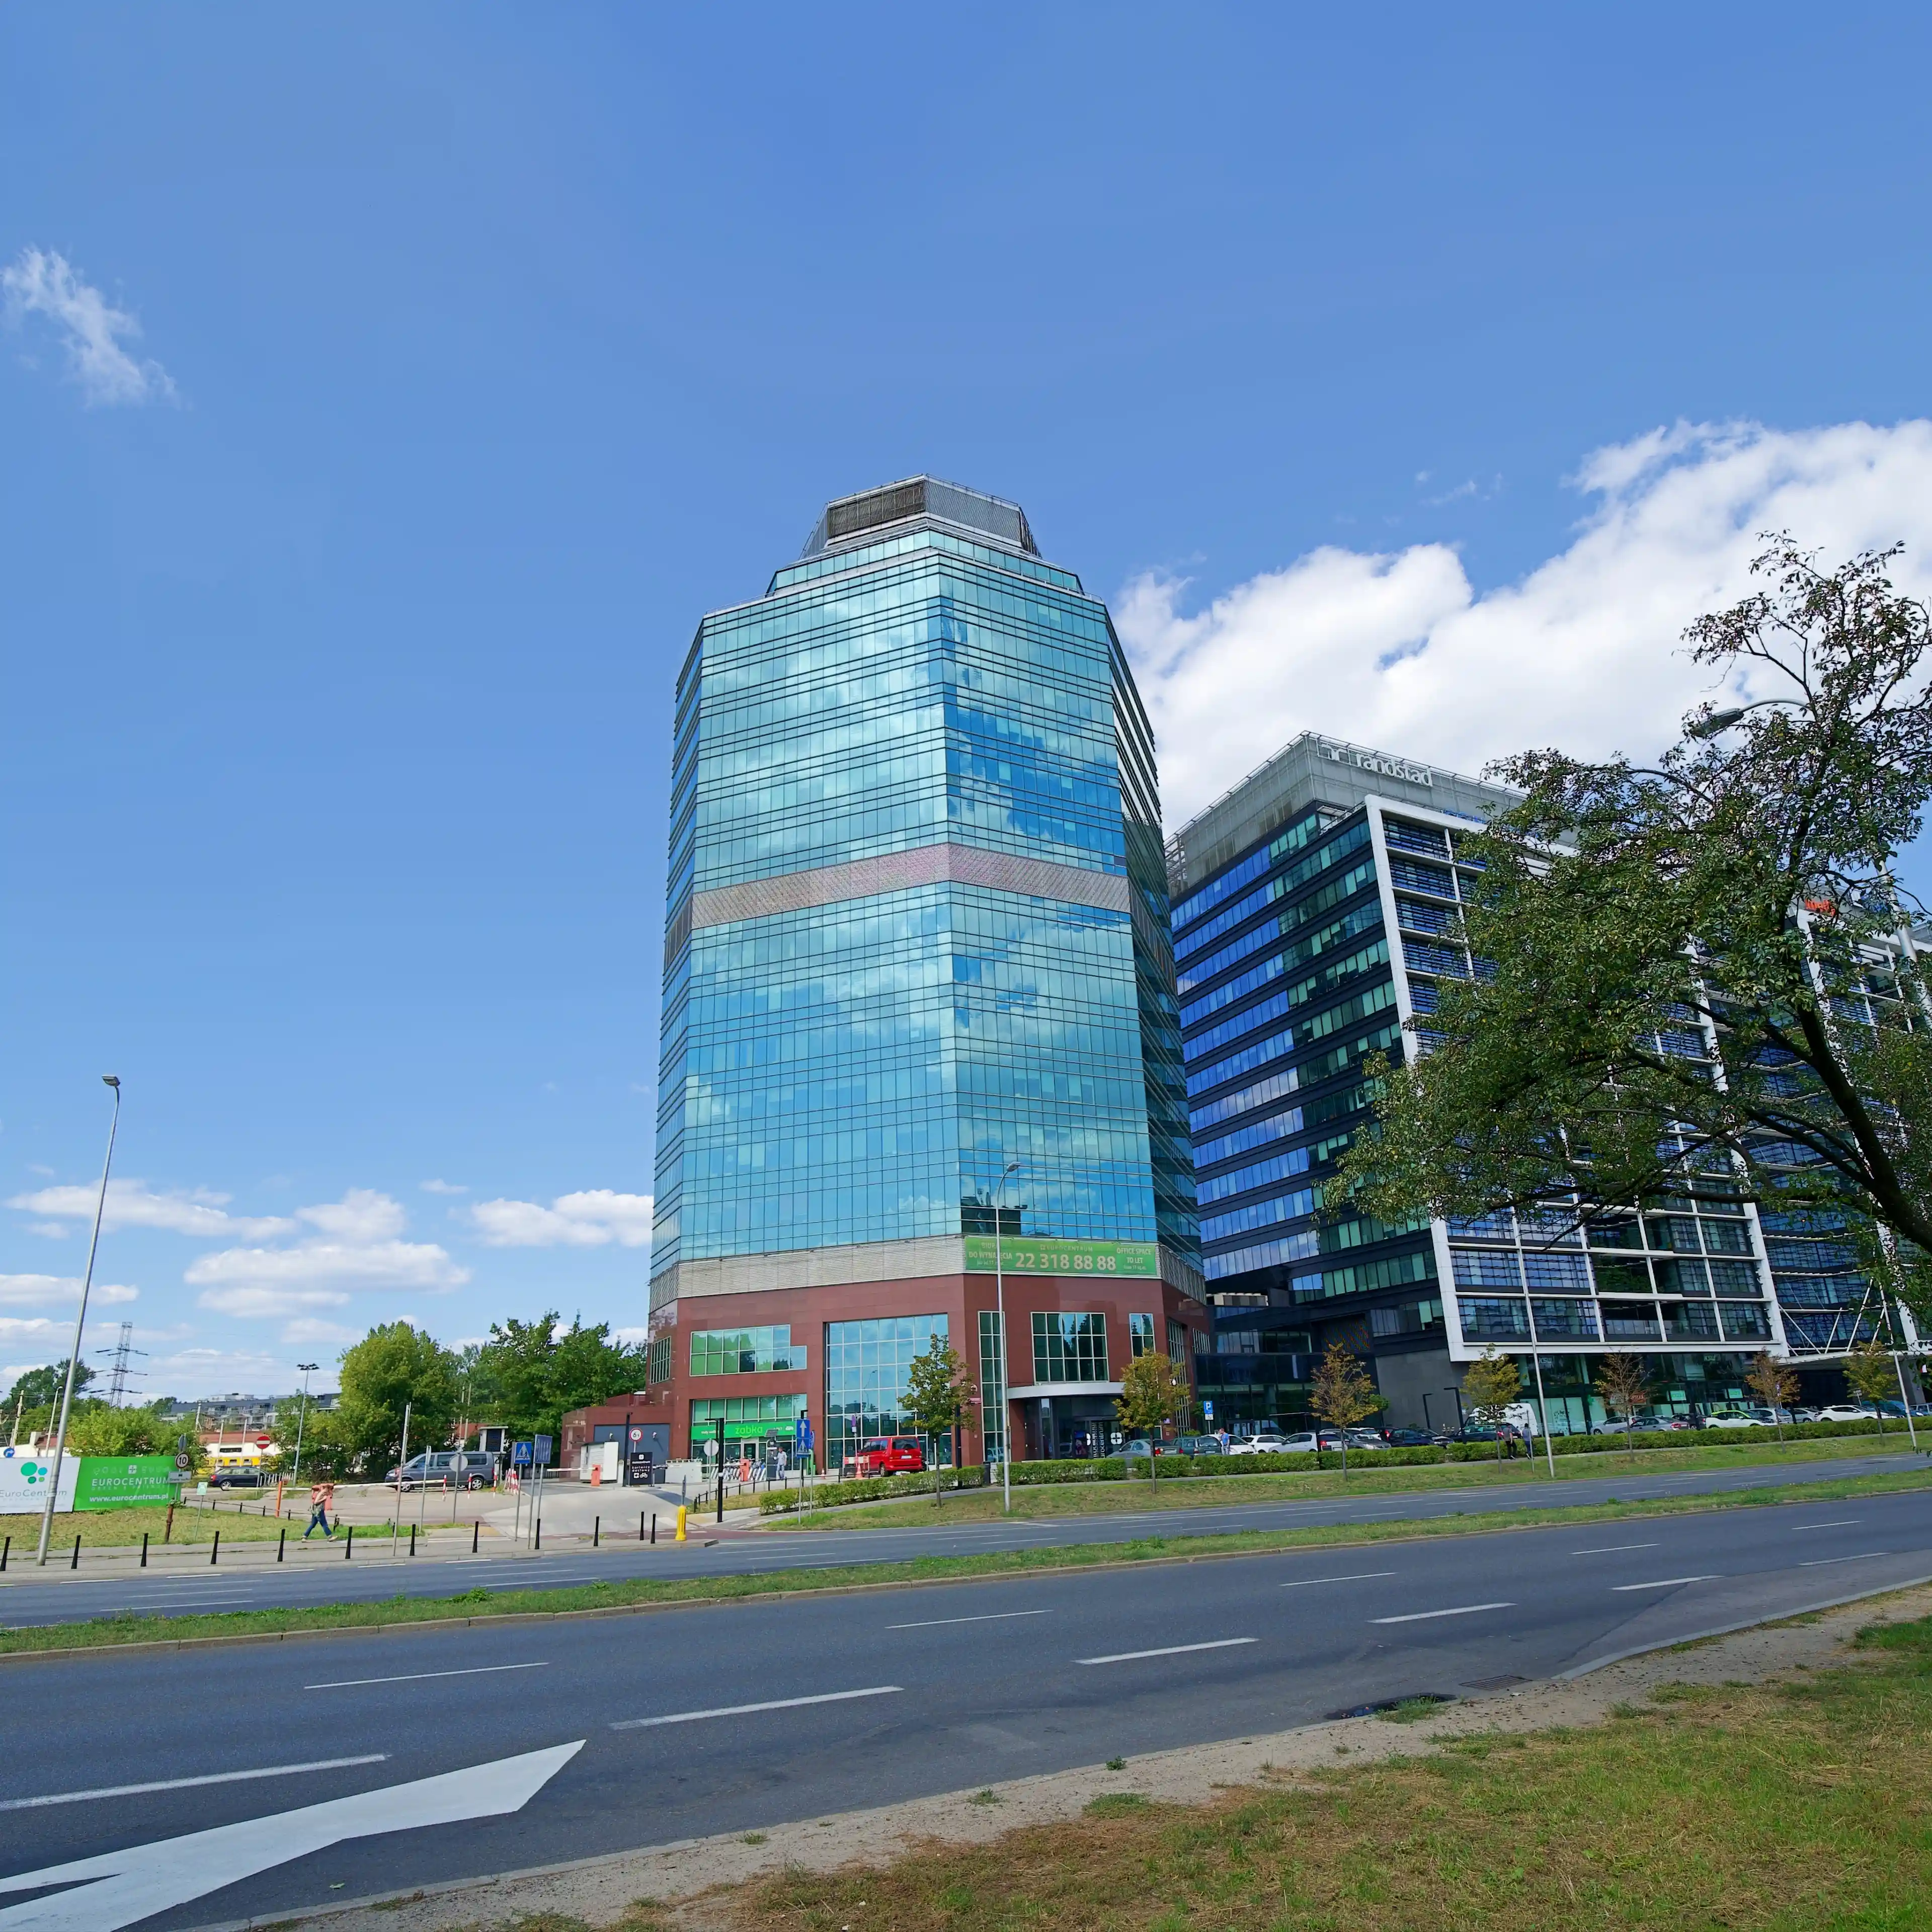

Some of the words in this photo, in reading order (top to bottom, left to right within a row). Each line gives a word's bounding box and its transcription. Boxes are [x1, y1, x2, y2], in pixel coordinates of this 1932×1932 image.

[1356, 754, 1433, 787] randstad
[1015, 1252, 1035, 1268] 22
[1040, 1253, 1070, 1269] 318
[1073, 1254, 1093, 1270] 88
[1097, 1255, 1116, 1270] 88
[735, 1425, 763, 1434] żabka
[179, 1457, 187, 1465] 10
[0, 1489, 67, 1497] EuroCentm
[89, 1493, 169, 1502] www.eurocentrum.pl
